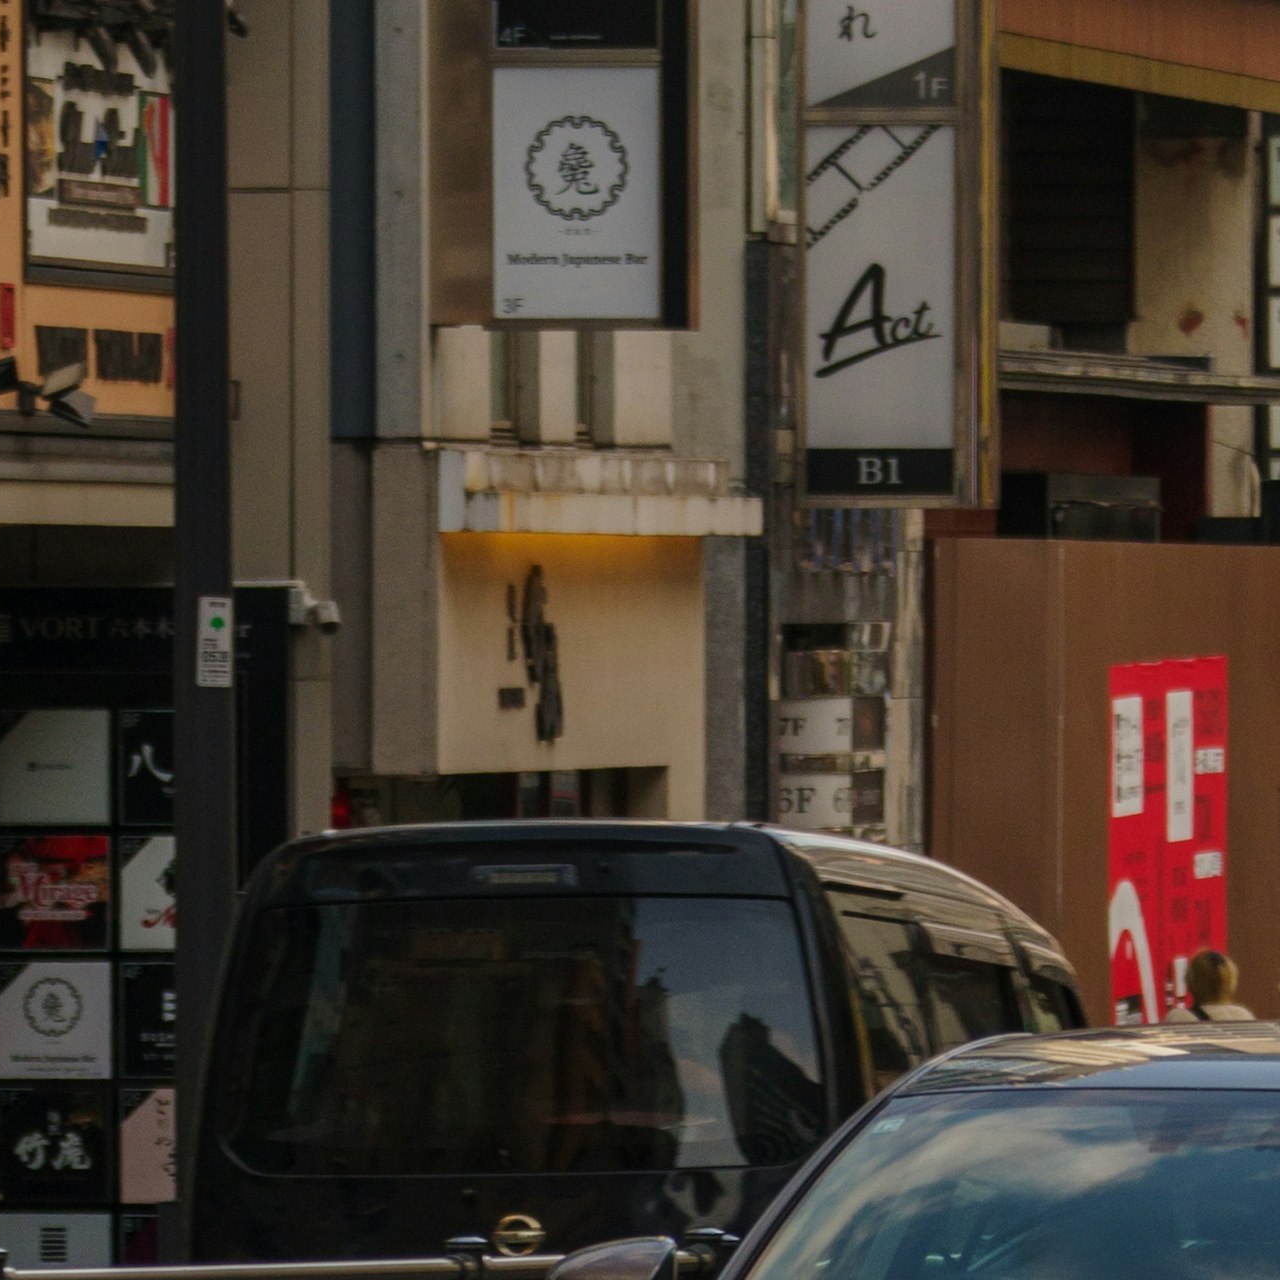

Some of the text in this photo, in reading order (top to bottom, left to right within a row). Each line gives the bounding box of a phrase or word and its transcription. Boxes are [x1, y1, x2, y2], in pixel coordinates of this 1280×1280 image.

[912, 70, 950, 99] 1F
[507, 253, 649, 268] Modern Japanese Bar
[817, 263, 940, 370] Act
[856, 455, 903, 485] B1
[779, 716, 806, 736] 7F
